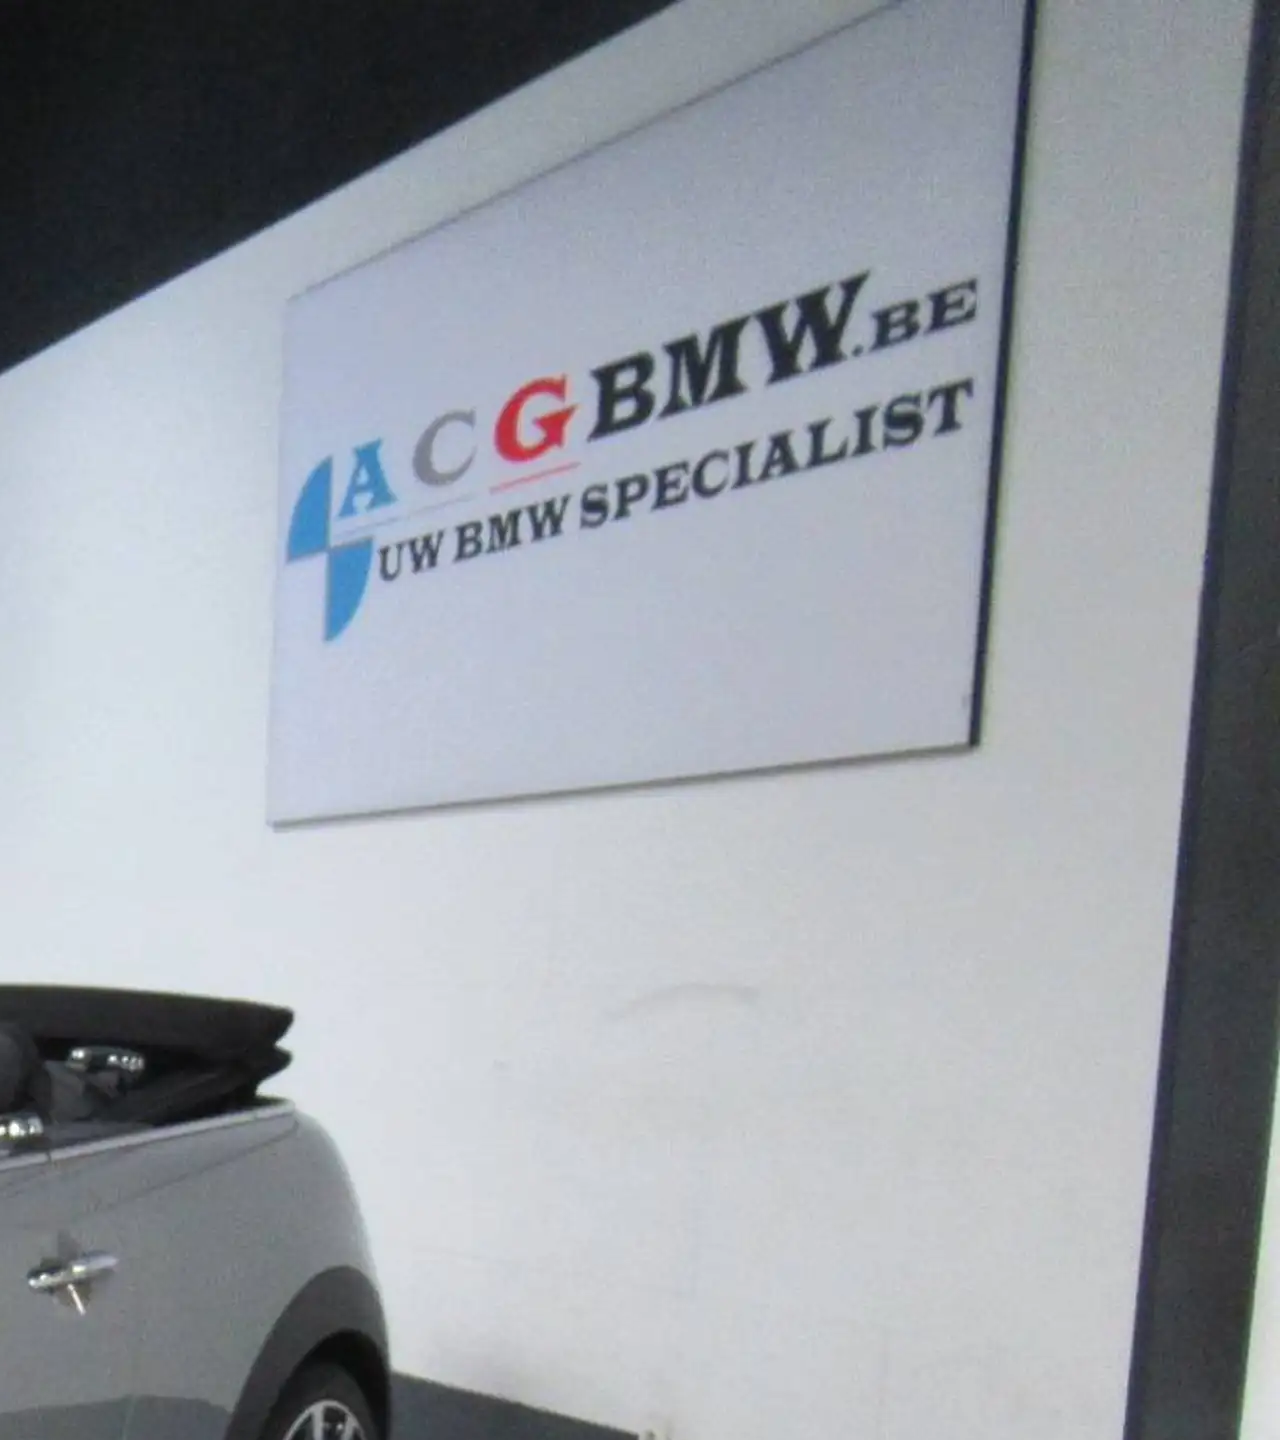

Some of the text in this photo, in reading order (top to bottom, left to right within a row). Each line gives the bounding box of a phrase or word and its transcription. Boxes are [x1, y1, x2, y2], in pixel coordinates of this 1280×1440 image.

[377, 379, 974, 582] UW BMW SPECIALIST
